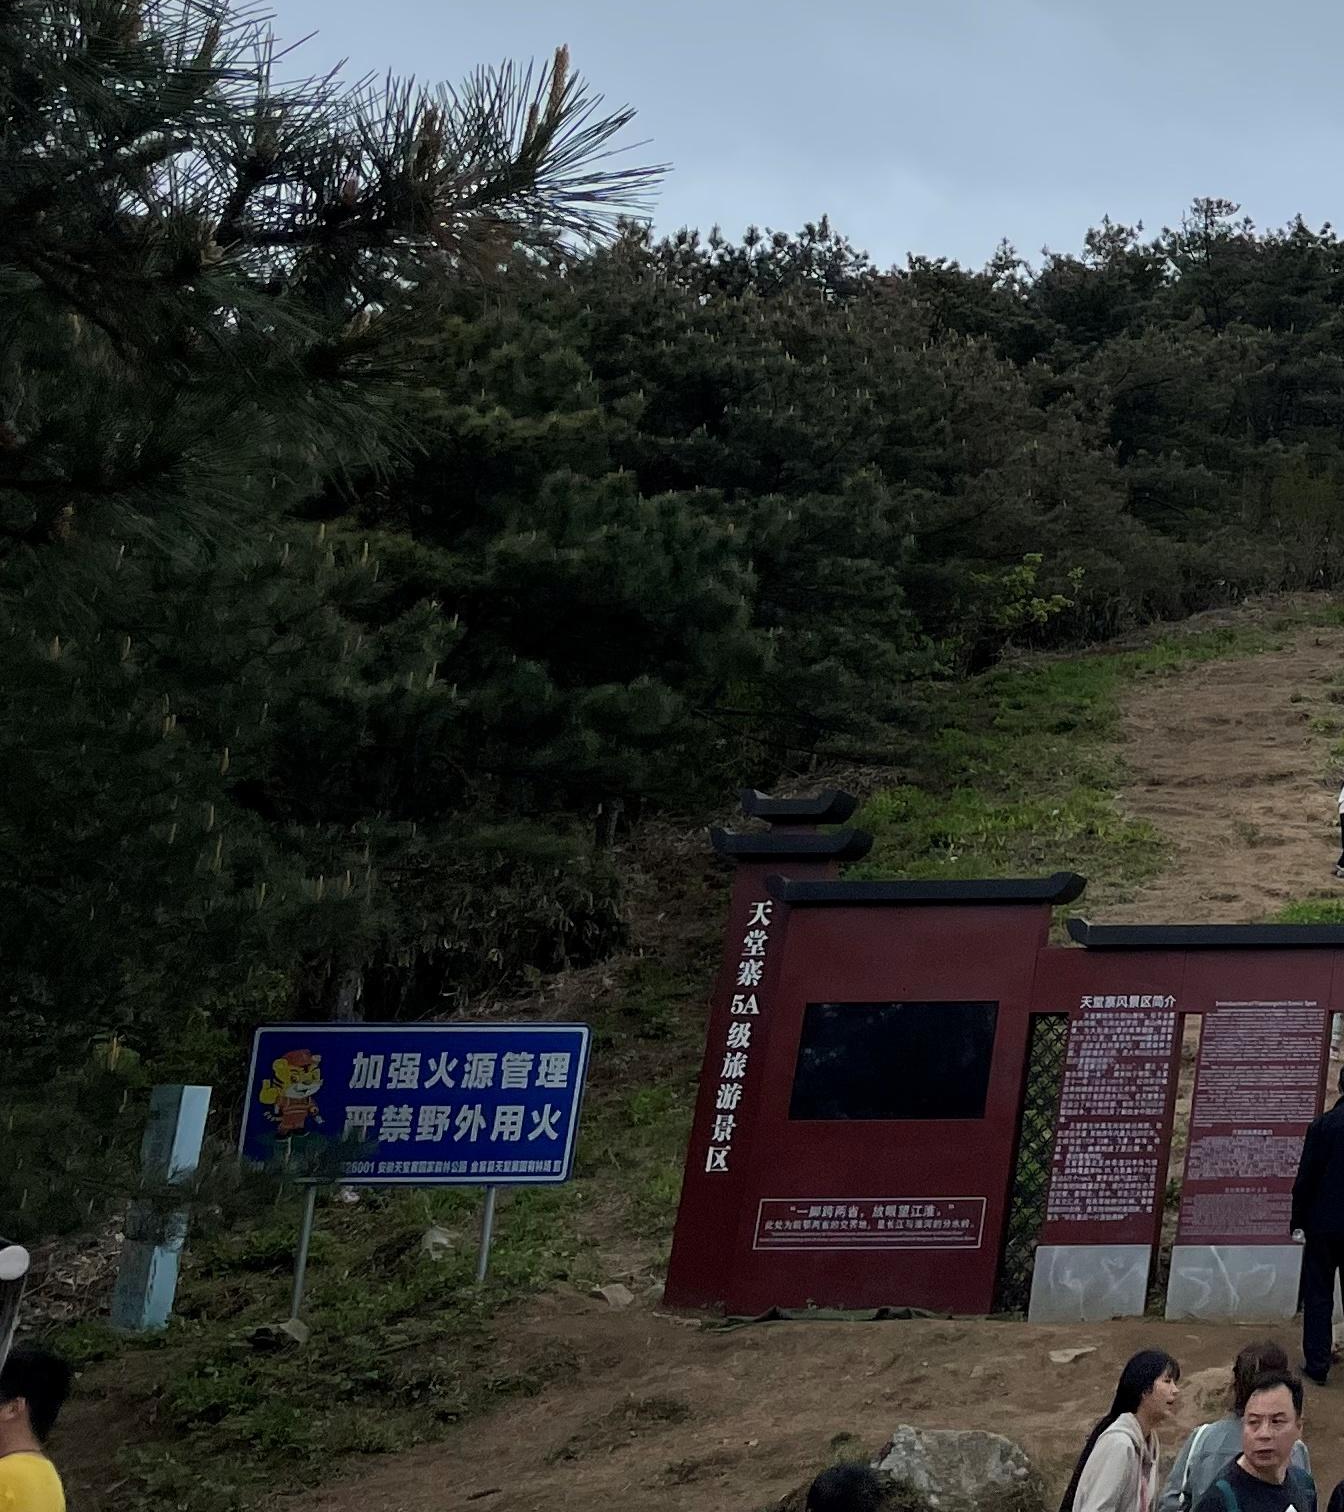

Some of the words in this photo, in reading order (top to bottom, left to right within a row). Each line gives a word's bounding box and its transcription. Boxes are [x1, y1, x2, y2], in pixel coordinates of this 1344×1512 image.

[1079, 995, 1177, 1009] 天堂寨风景区简介
[704, 900, 774, 1173] 天堂寨5A级旅游景区
[349, 1051, 572, 1090] 加强火源管理
[341, 1103, 562, 1142] 严禁野外用火
